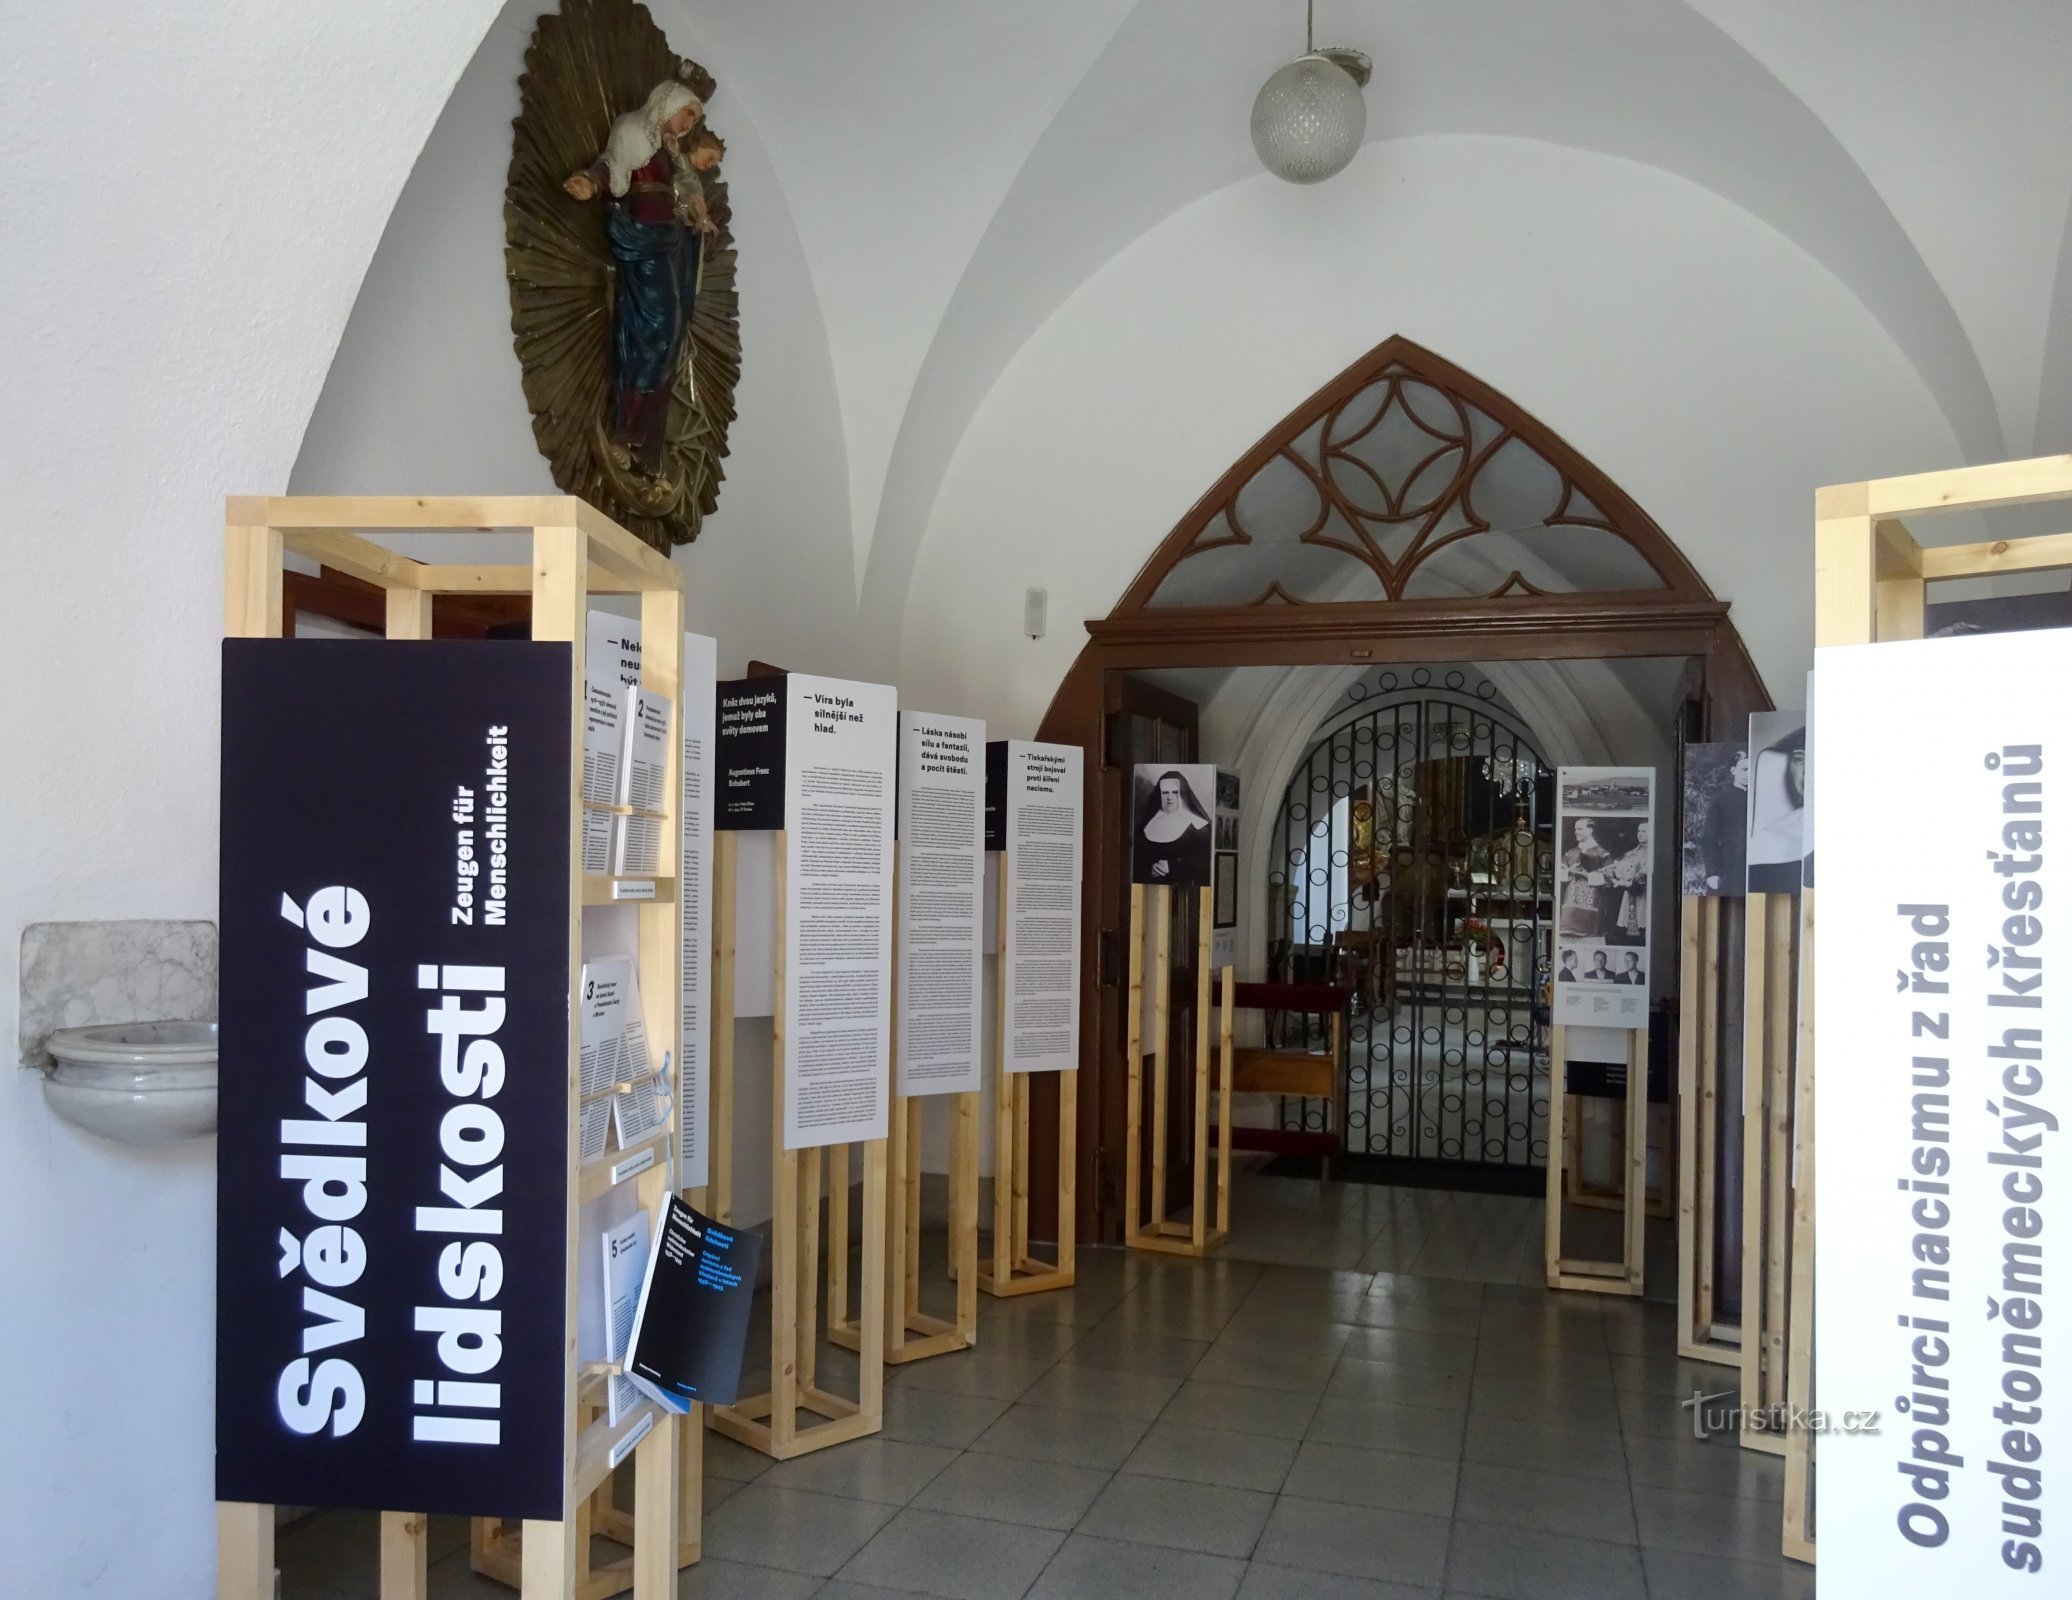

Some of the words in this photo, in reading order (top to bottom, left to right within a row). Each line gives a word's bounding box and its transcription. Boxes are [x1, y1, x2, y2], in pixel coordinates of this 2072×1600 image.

[621, 659, 642, 671] neu
[638, 699, 644, 717] 2
[738, 697, 754, 706] dvou
[814, 693, 833, 705] Víra
[835, 696, 854, 708] byla
[741, 710, 754, 722] byly
[755, 709, 767, 719] oba
[814, 708, 847, 722] silnější
[848, 713, 864, 723] než
[722, 725, 739, 737] světy
[739, 724, 769, 735] domovem
[814, 722, 836, 734] hlad.
[921, 727, 943, 737] Láska
[941, 741, 970, 753] fantazii,
[921, 751, 938, 760] dává
[939, 753, 968, 763] svobodu
[755, 767, 770, 776] Franz
[927, 764, 945, 773] pocit
[1044, 765, 1066, 774] bojoval
[1026, 774, 1041, 782] proti
[452, 785, 475, 825] für
[485, 725, 508, 926] Menschlichkeit
[452, 830, 479, 926] Zeugen
[1984, 745, 2043, 1008] křesťanů
[1897, 904, 1949, 994] řad
[587, 980, 594, 1000] 3
[1912, 1011, 1949, 1039] z
[277, 885, 371, 1438] Svědkové
[1897, 1057, 1950, 1301] nacismu
[413, 964, 507, 1445] lidskosti
[612, 1239, 618, 1258] 5
[1987, 1028, 2059, 1573] sudetoněmeckých
[1895, 1315, 1963, 1548] Odpůrci
